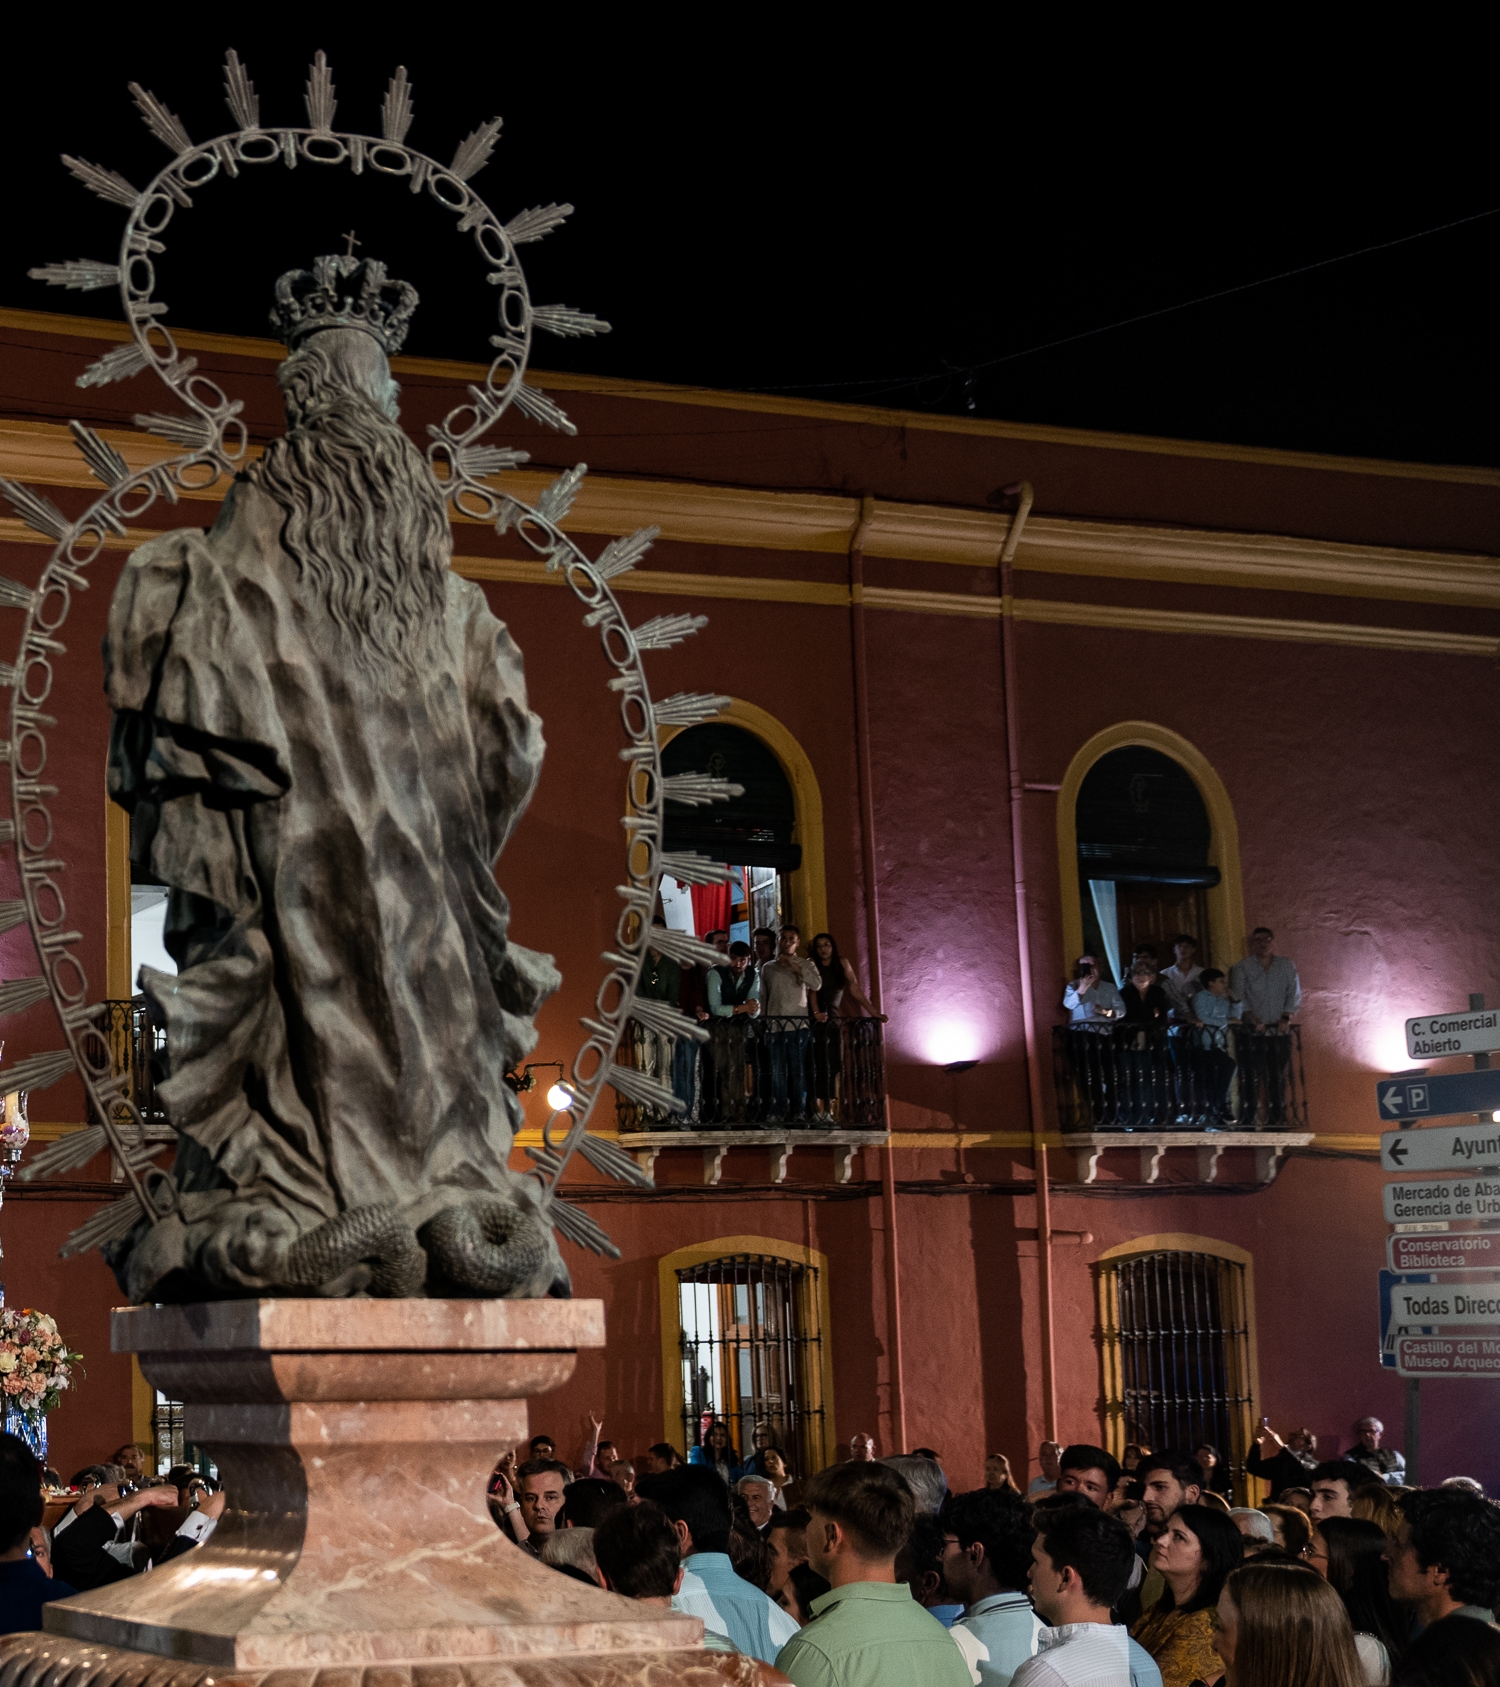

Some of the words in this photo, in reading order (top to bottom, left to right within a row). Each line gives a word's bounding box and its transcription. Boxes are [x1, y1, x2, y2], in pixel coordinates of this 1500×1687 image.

[1411, 1022, 1425, 1036] C.
[1430, 1014, 1497, 1034] Comercial
[1413, 1038, 1461, 1055] Abierto
[1392, 1185, 1449, 1201] Mercado
[1453, 1183, 1470, 1198] de
[1474, 1182, 1500, 1197] Aba
[1394, 1201, 1451, 1217] Gerencia
[1455, 1200, 1472, 1215] de
[1476, 1199, 1500, 1214] Urb
[1398, 1237, 1491, 1253] Conservatorio
[1400, 1254, 1466, 1267] Biblioteca
[1403, 1295, 1449, 1315] Todas
[1403, 1341, 1453, 1354] Castillo
[1457, 1341, 1478, 1354] del
[1404, 1355, 1449, 1367] Museo
[1453, 1355, 1500, 1371] Arqueo
